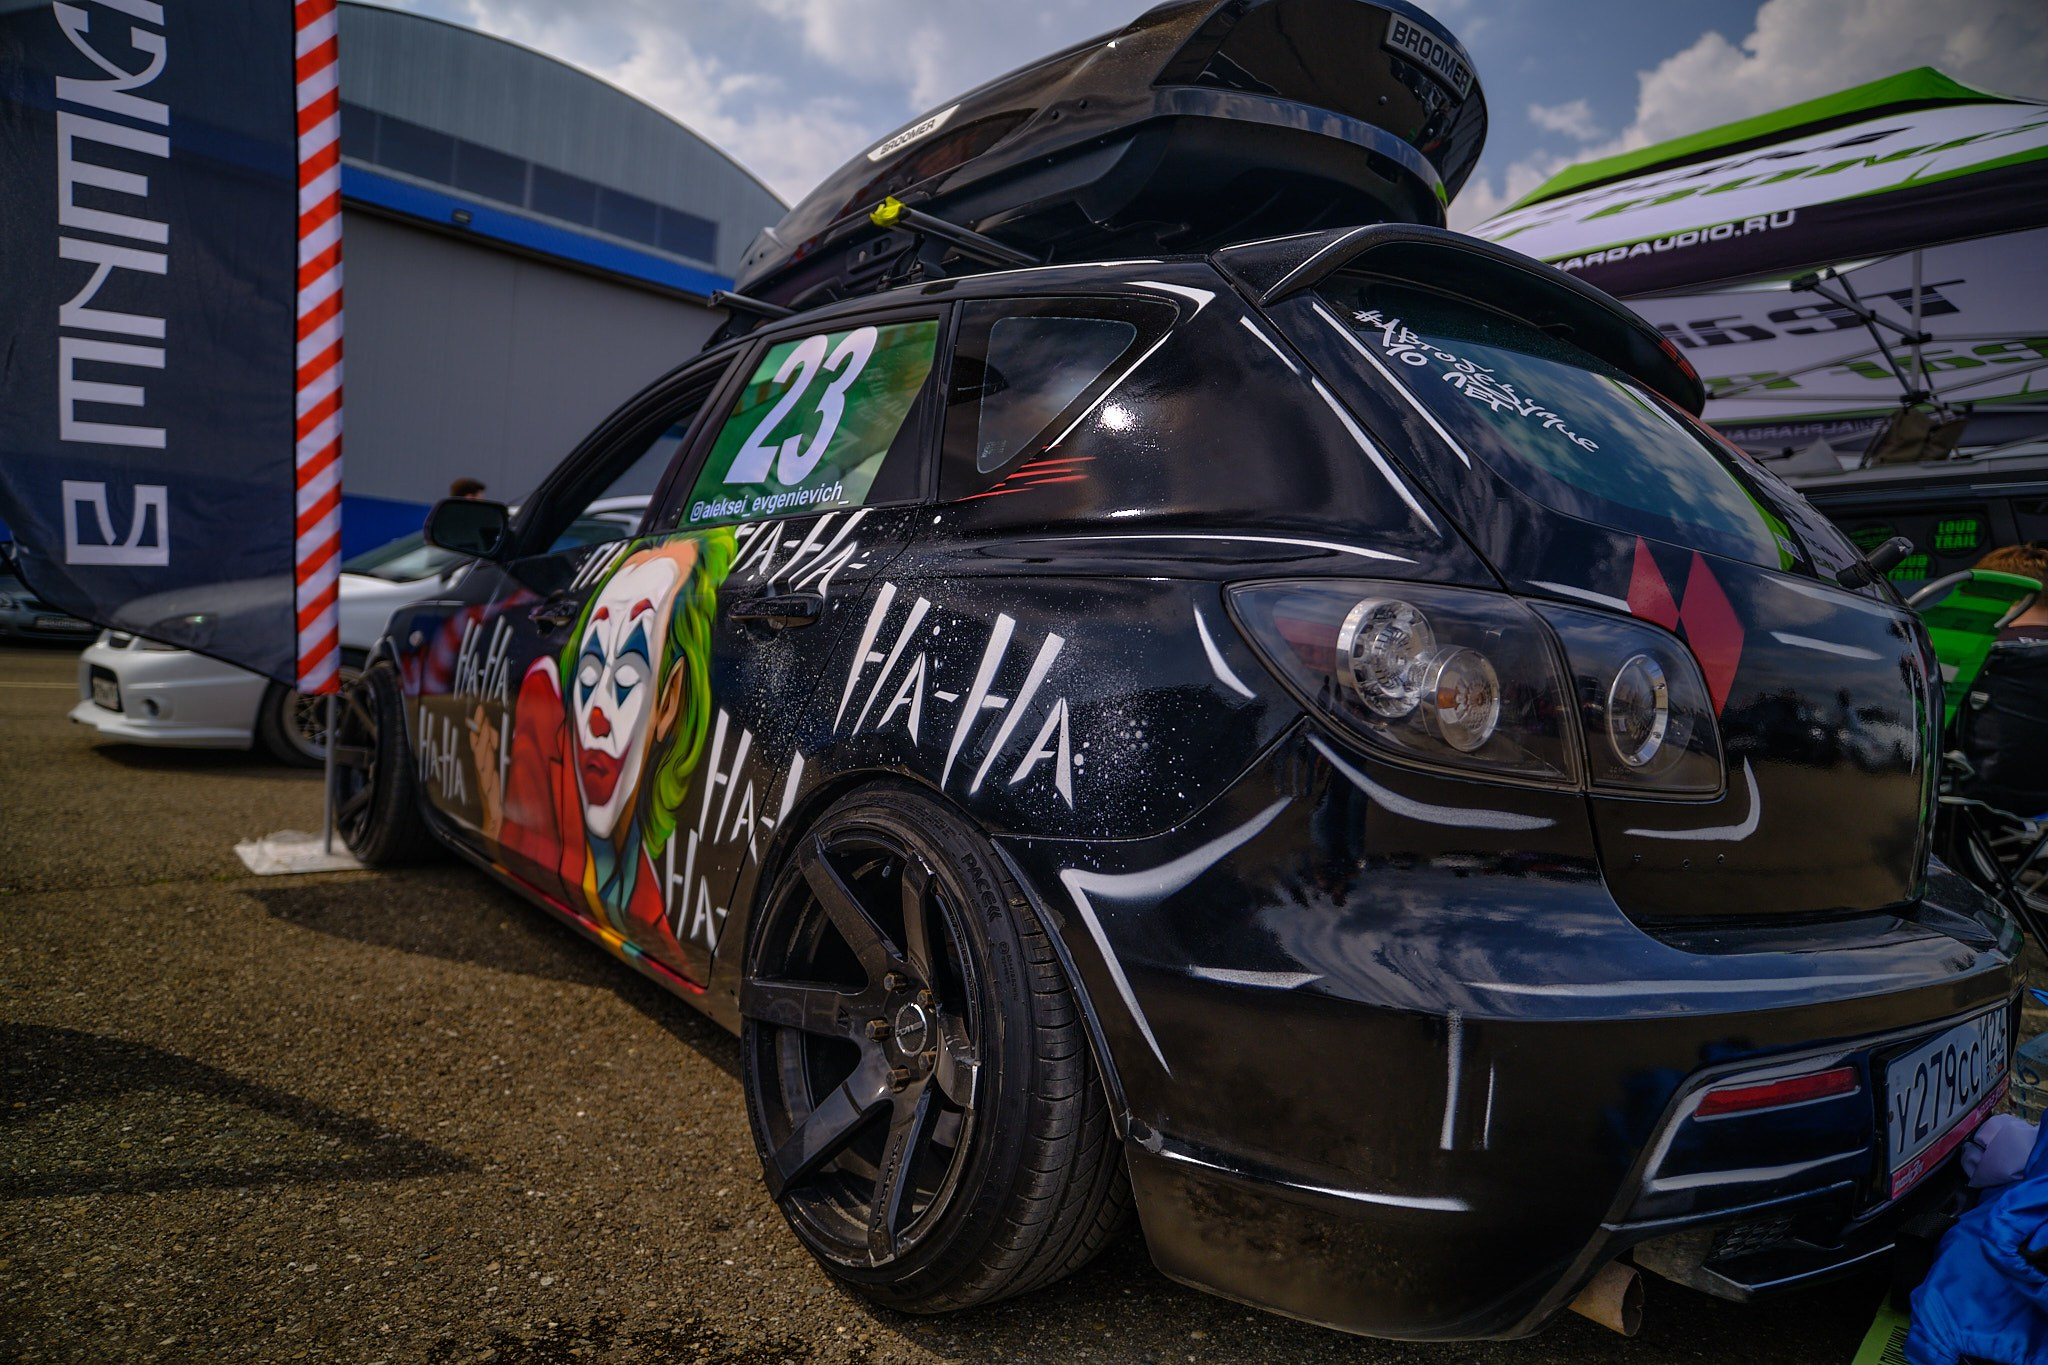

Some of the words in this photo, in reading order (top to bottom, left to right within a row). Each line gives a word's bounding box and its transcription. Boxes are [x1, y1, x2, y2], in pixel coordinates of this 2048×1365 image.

[1392, 21, 1470, 93] BROOMER
[880, 119, 936, 155] BROOMER
[1386, 343, 1428, 366] 10
[722, 326, 878, 486] 23
[1934, 534, 1978, 550] TRAIL
[1937, 519, 1978, 534] LOUD
[833, 581, 1073, 810] HA-HA
